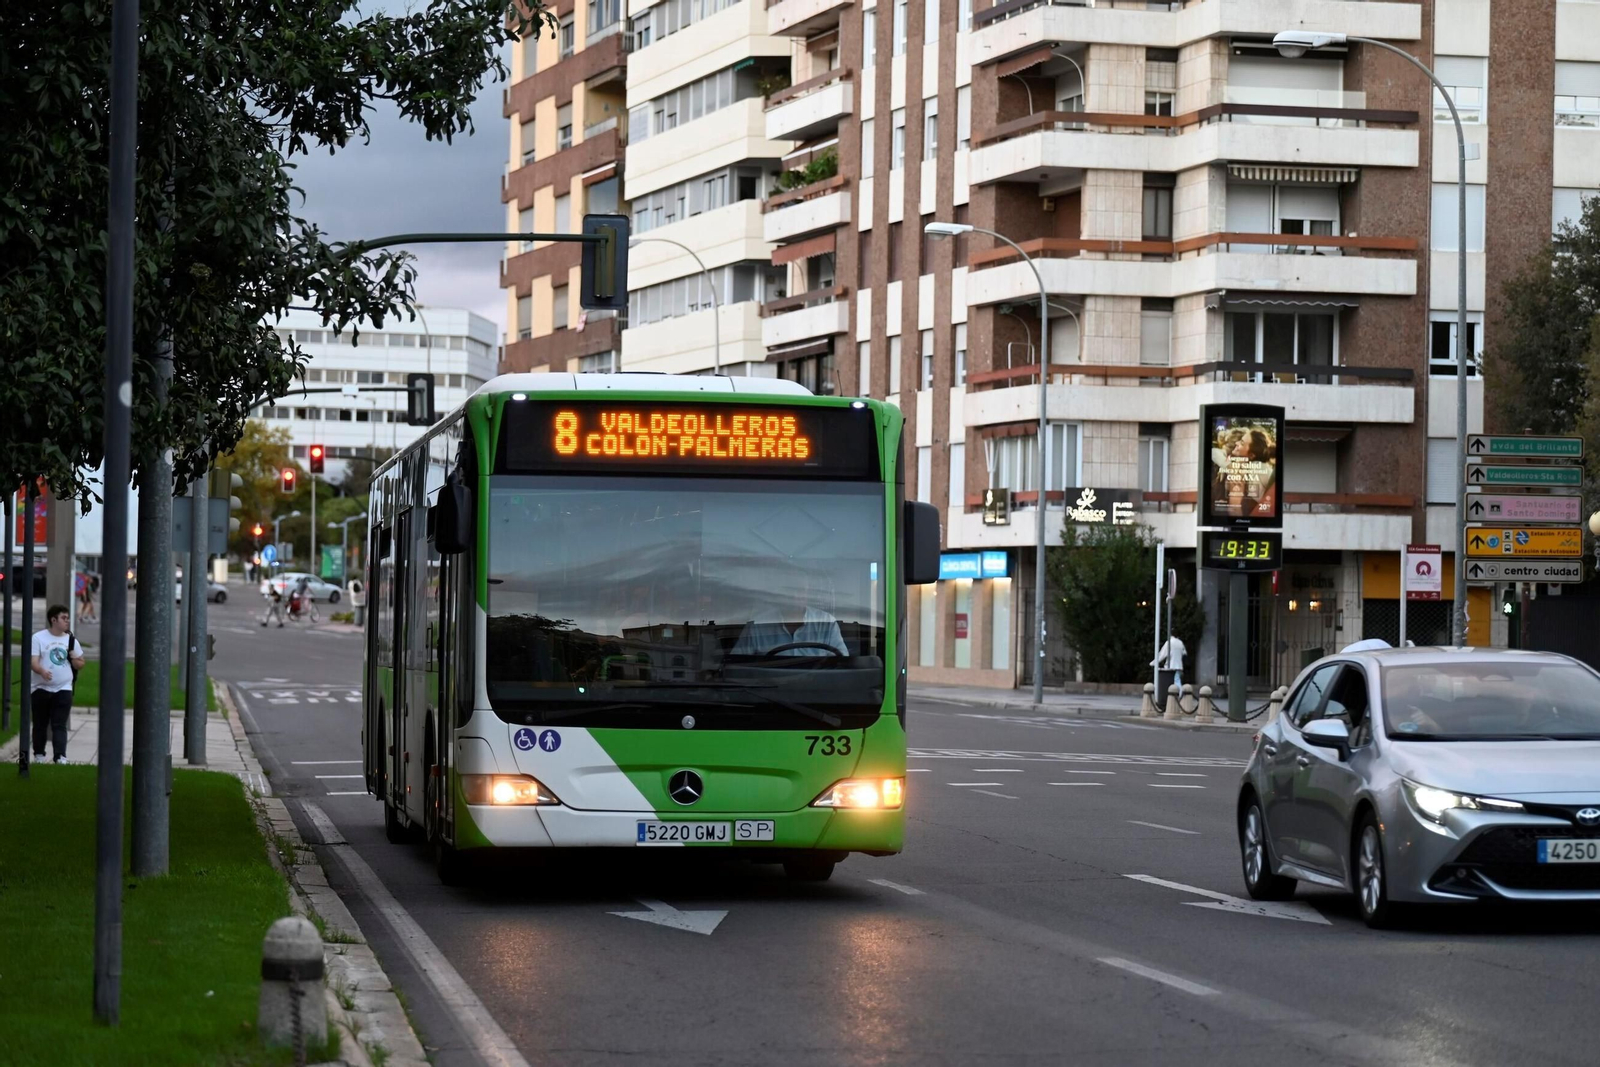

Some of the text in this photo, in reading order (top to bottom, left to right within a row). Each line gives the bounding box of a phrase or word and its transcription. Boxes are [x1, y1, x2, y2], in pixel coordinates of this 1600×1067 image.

[601, 413, 796, 436] VALDEOLLEROS
[555, 411, 578, 454] 8
[586, 434, 809, 458] COLON-PALMERAS
[1492, 442, 1514, 450] avda
[1536, 443, 1578, 451] Brillante
[1241, 461, 1262, 469] salud
[1066, 505, 1107, 518] Rabasco
[1516, 500, 1577, 509] Santuario de
[1507, 509, 1577, 520] Santo Domingo
[1219, 541, 1270, 558] 19:33
[1504, 566, 1579, 576] centro ciudad
[804, 735, 852, 756] 733
[647, 825, 690, 840] 5220
[695, 825, 726, 840] GMJ
[1551, 843, 1597, 860] 4250
